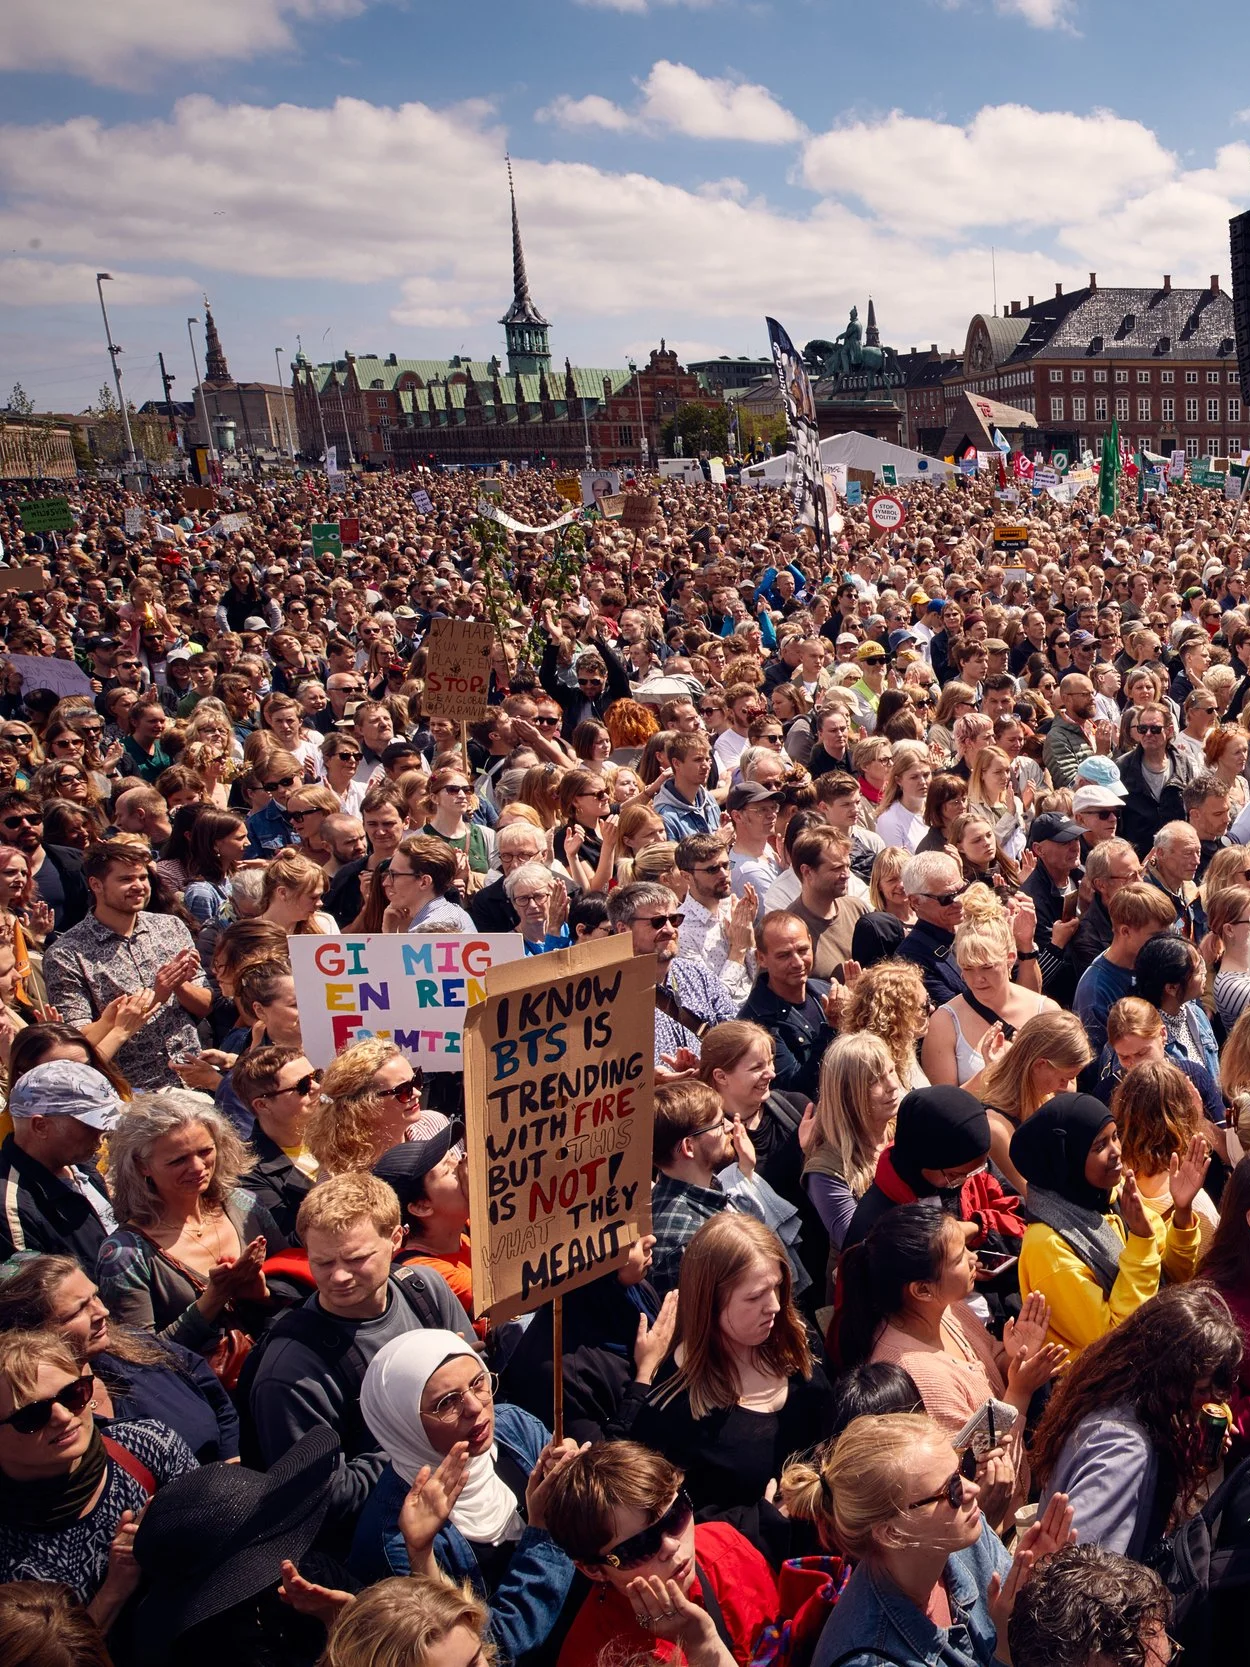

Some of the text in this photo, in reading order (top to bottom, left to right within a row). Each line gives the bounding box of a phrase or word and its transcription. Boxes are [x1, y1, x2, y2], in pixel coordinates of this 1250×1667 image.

[434, 639, 458, 651] KUN
[435, 620, 493, 640] VI HAR
[428, 672, 483, 692] STOP
[428, 691, 452, 703] DEN
[402, 941, 492, 977] MIG
[325, 978, 488, 1012] EN REN
[497, 970, 622, 1038] I KNOW
[490, 1011, 612, 1082] BTS IS
[488, 1052, 644, 1123] TRENDING
[487, 1111, 566, 1161] WITH
[488, 1119, 634, 1198] BUT THIS
[489, 1151, 625, 1226] IS NOT!
[481, 1181, 638, 1269] WHAT THEY
[521, 1220, 626, 1301] MEANT
